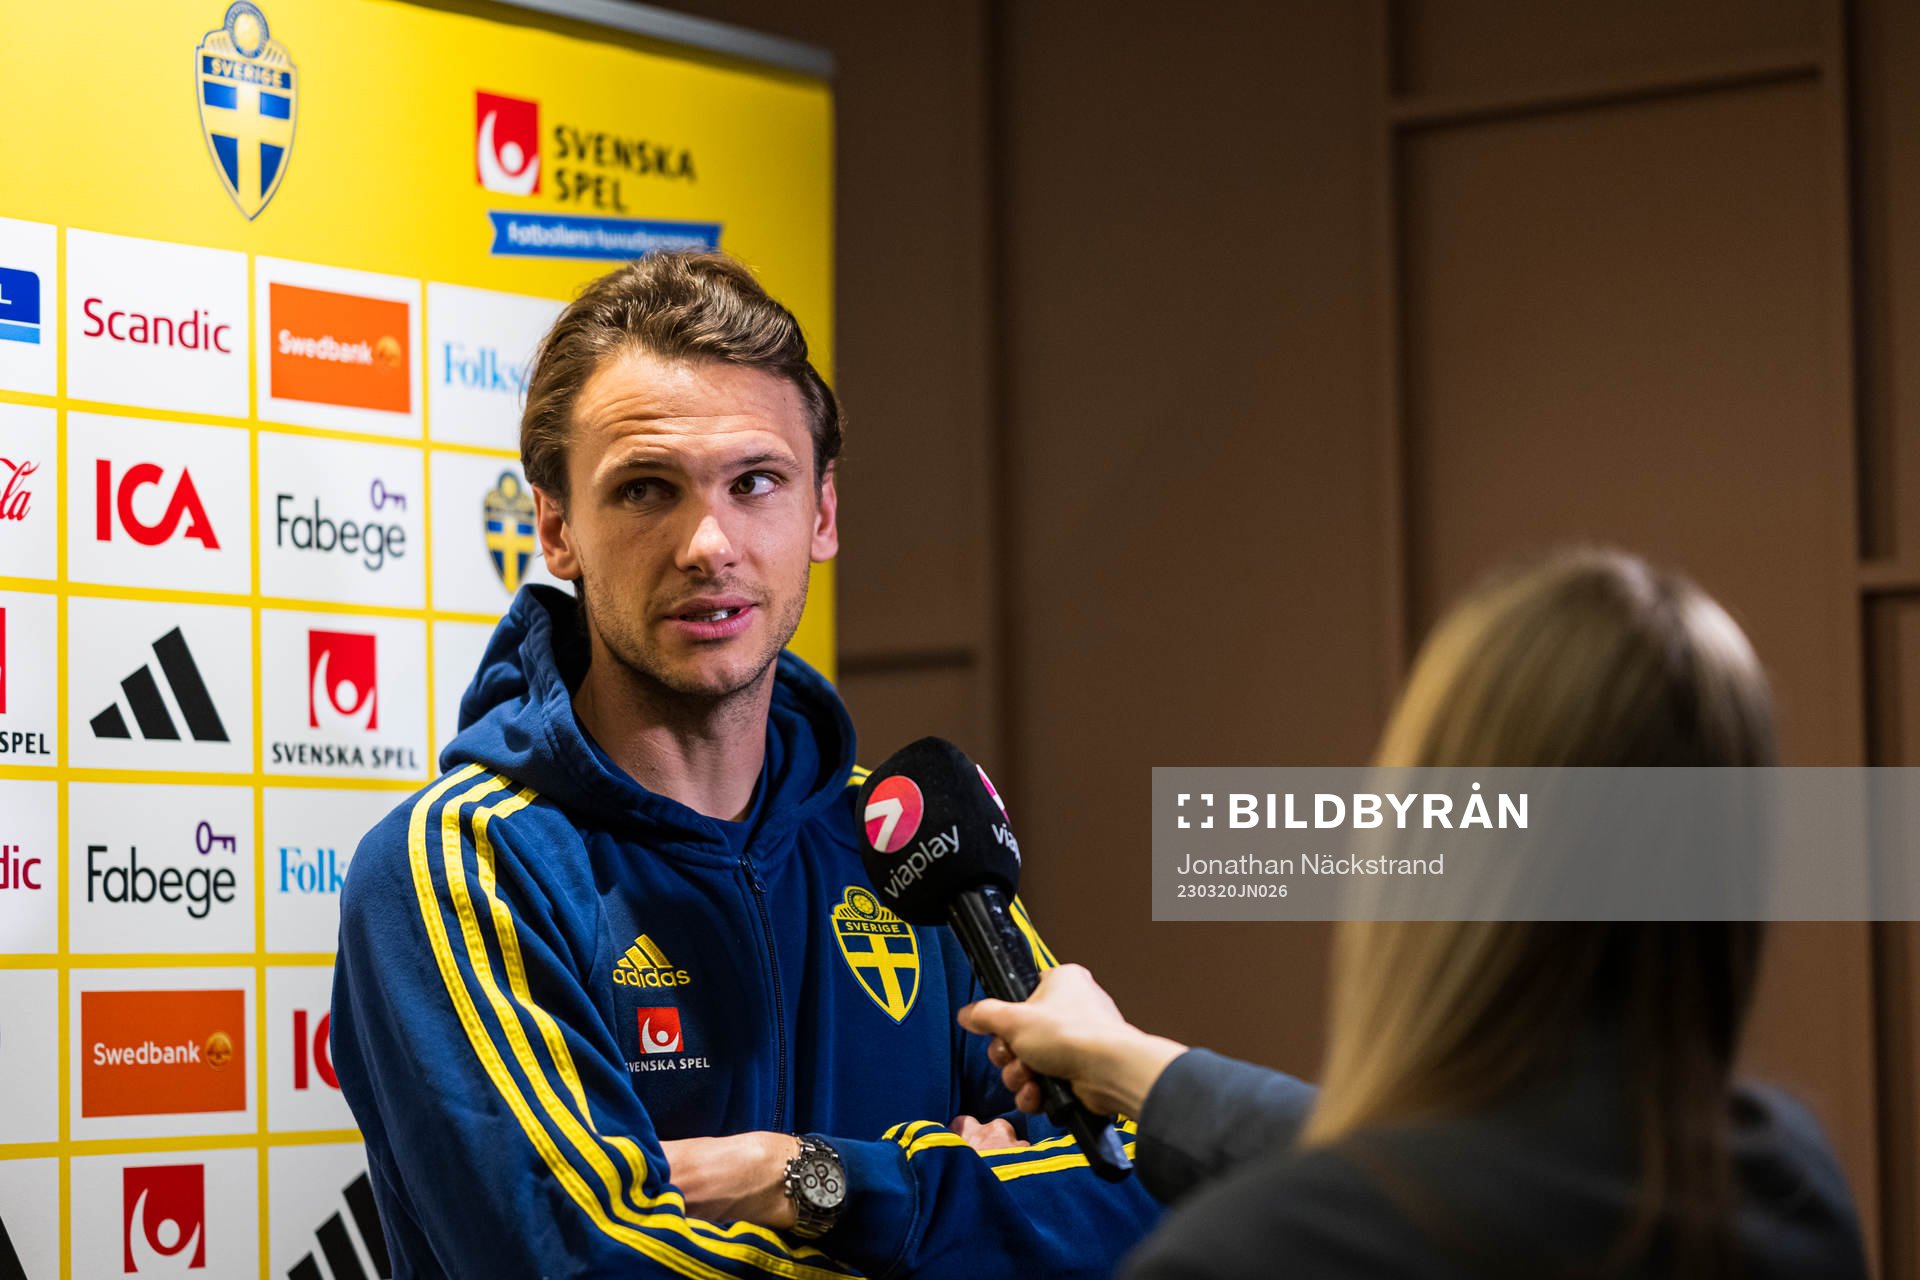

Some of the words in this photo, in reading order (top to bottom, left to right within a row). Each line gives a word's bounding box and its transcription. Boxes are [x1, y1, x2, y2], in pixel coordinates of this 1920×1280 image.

[210, 58, 284, 88] SVERIGE
[554, 124, 698, 182] SVENSKA
[555, 169, 629, 213] SPEL
[83, 298, 232, 355] Scandic
[278, 329, 374, 365] Swedbank
[96, 459, 221, 550] ICA
[277, 494, 407, 571] Fabege
[0, 731, 51, 755] SPEL
[272, 742, 364, 767] SVENSKA
[371, 747, 419, 770] SPEL
[884, 825, 961, 899] viaplay
[991, 822, 1022, 868] via
[87, 845, 236, 919] Fabege
[279, 847, 345, 893] Folk
[845, 921, 901, 933] SVERIGE
[612, 967, 692, 988] adidas
[94, 1041, 201, 1066] Swedbank
[293, 1009, 341, 1091] IC
[679, 1057, 711, 1070] SPEL
